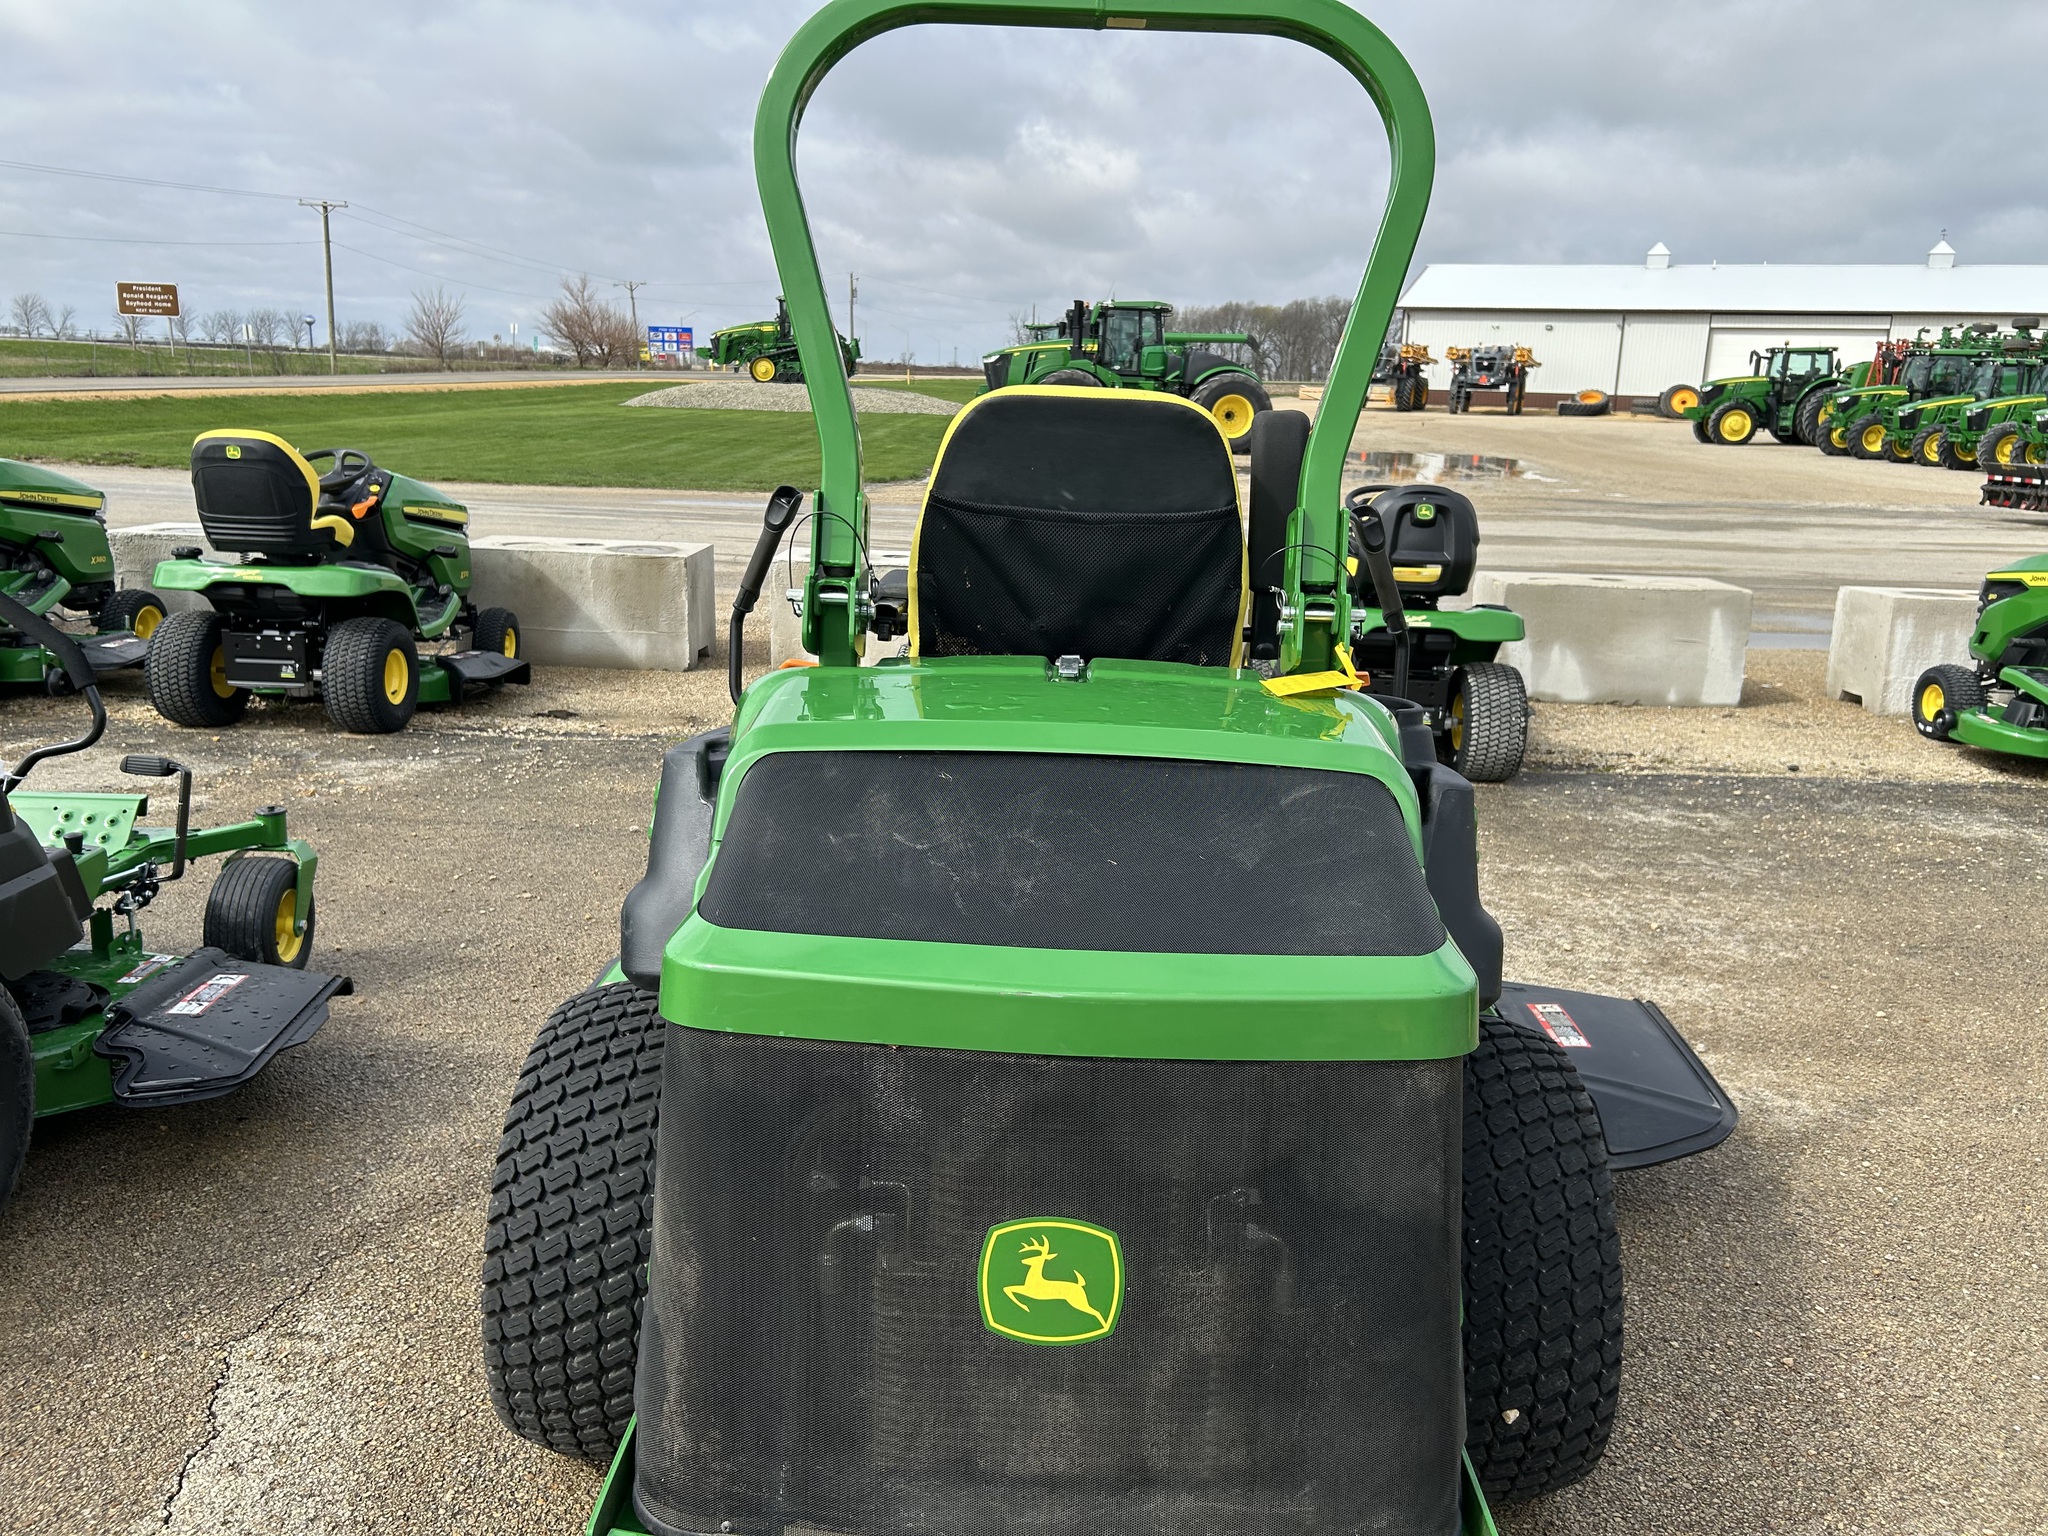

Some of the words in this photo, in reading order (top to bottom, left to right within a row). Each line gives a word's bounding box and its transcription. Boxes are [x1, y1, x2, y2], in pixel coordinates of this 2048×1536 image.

[19, 492, 36, 500] JOHN
[37, 494, 58, 503] DEERE
[417, 507, 429, 516] JOHN
